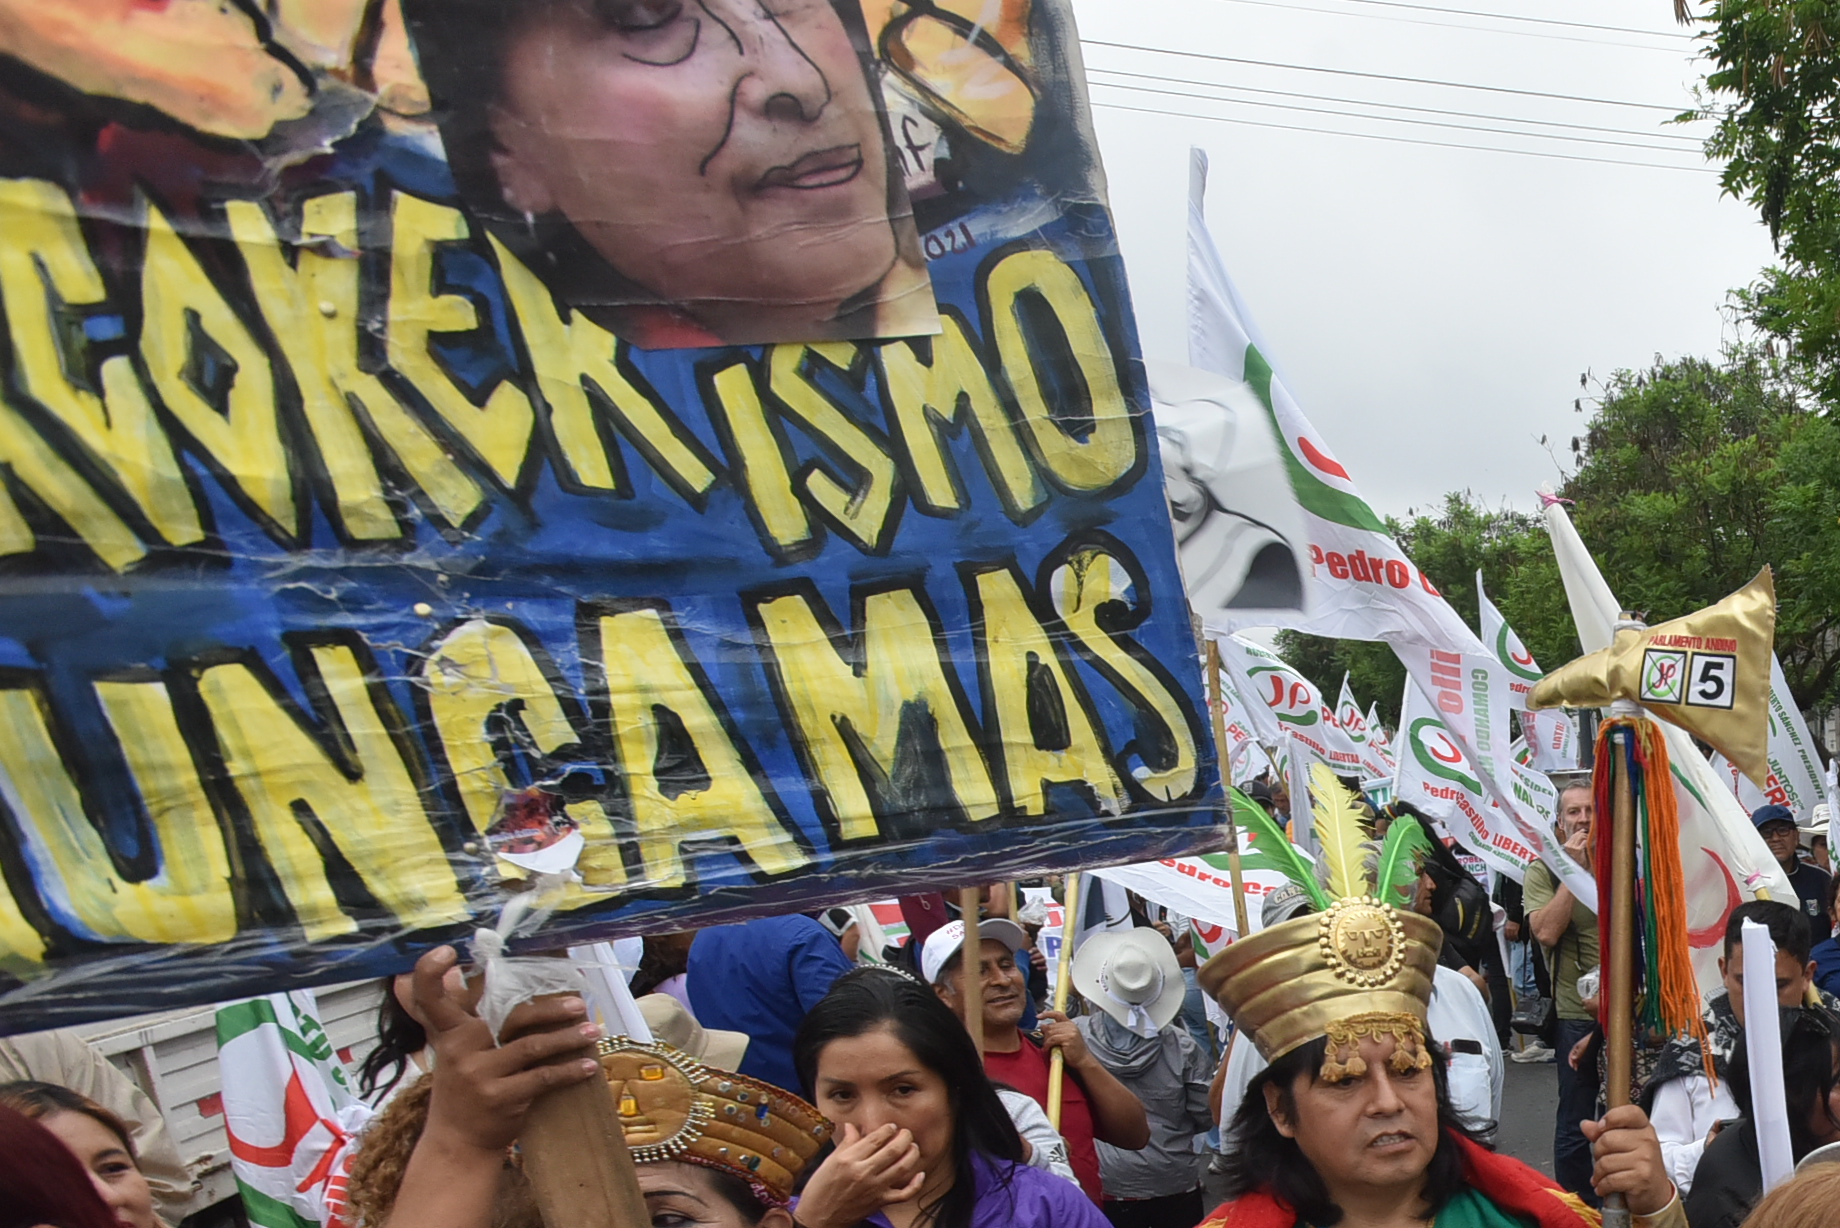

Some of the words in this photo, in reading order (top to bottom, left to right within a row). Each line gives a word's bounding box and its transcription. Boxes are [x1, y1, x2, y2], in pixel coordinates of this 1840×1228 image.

[1648, 635, 1702, 650] PARLAMENTO
[1704, 638, 1738, 652] ANDINO
[1698, 660, 1725, 701] 5
[0, 604, 806, 978] UNCA
[756, 547, 1200, 842] MAS
[1777, 709, 1804, 748] SÁNCHEZ
[1797, 747, 1827, 801] PRESIDENTE
[1767, 757, 1799, 802] JUNTOS
